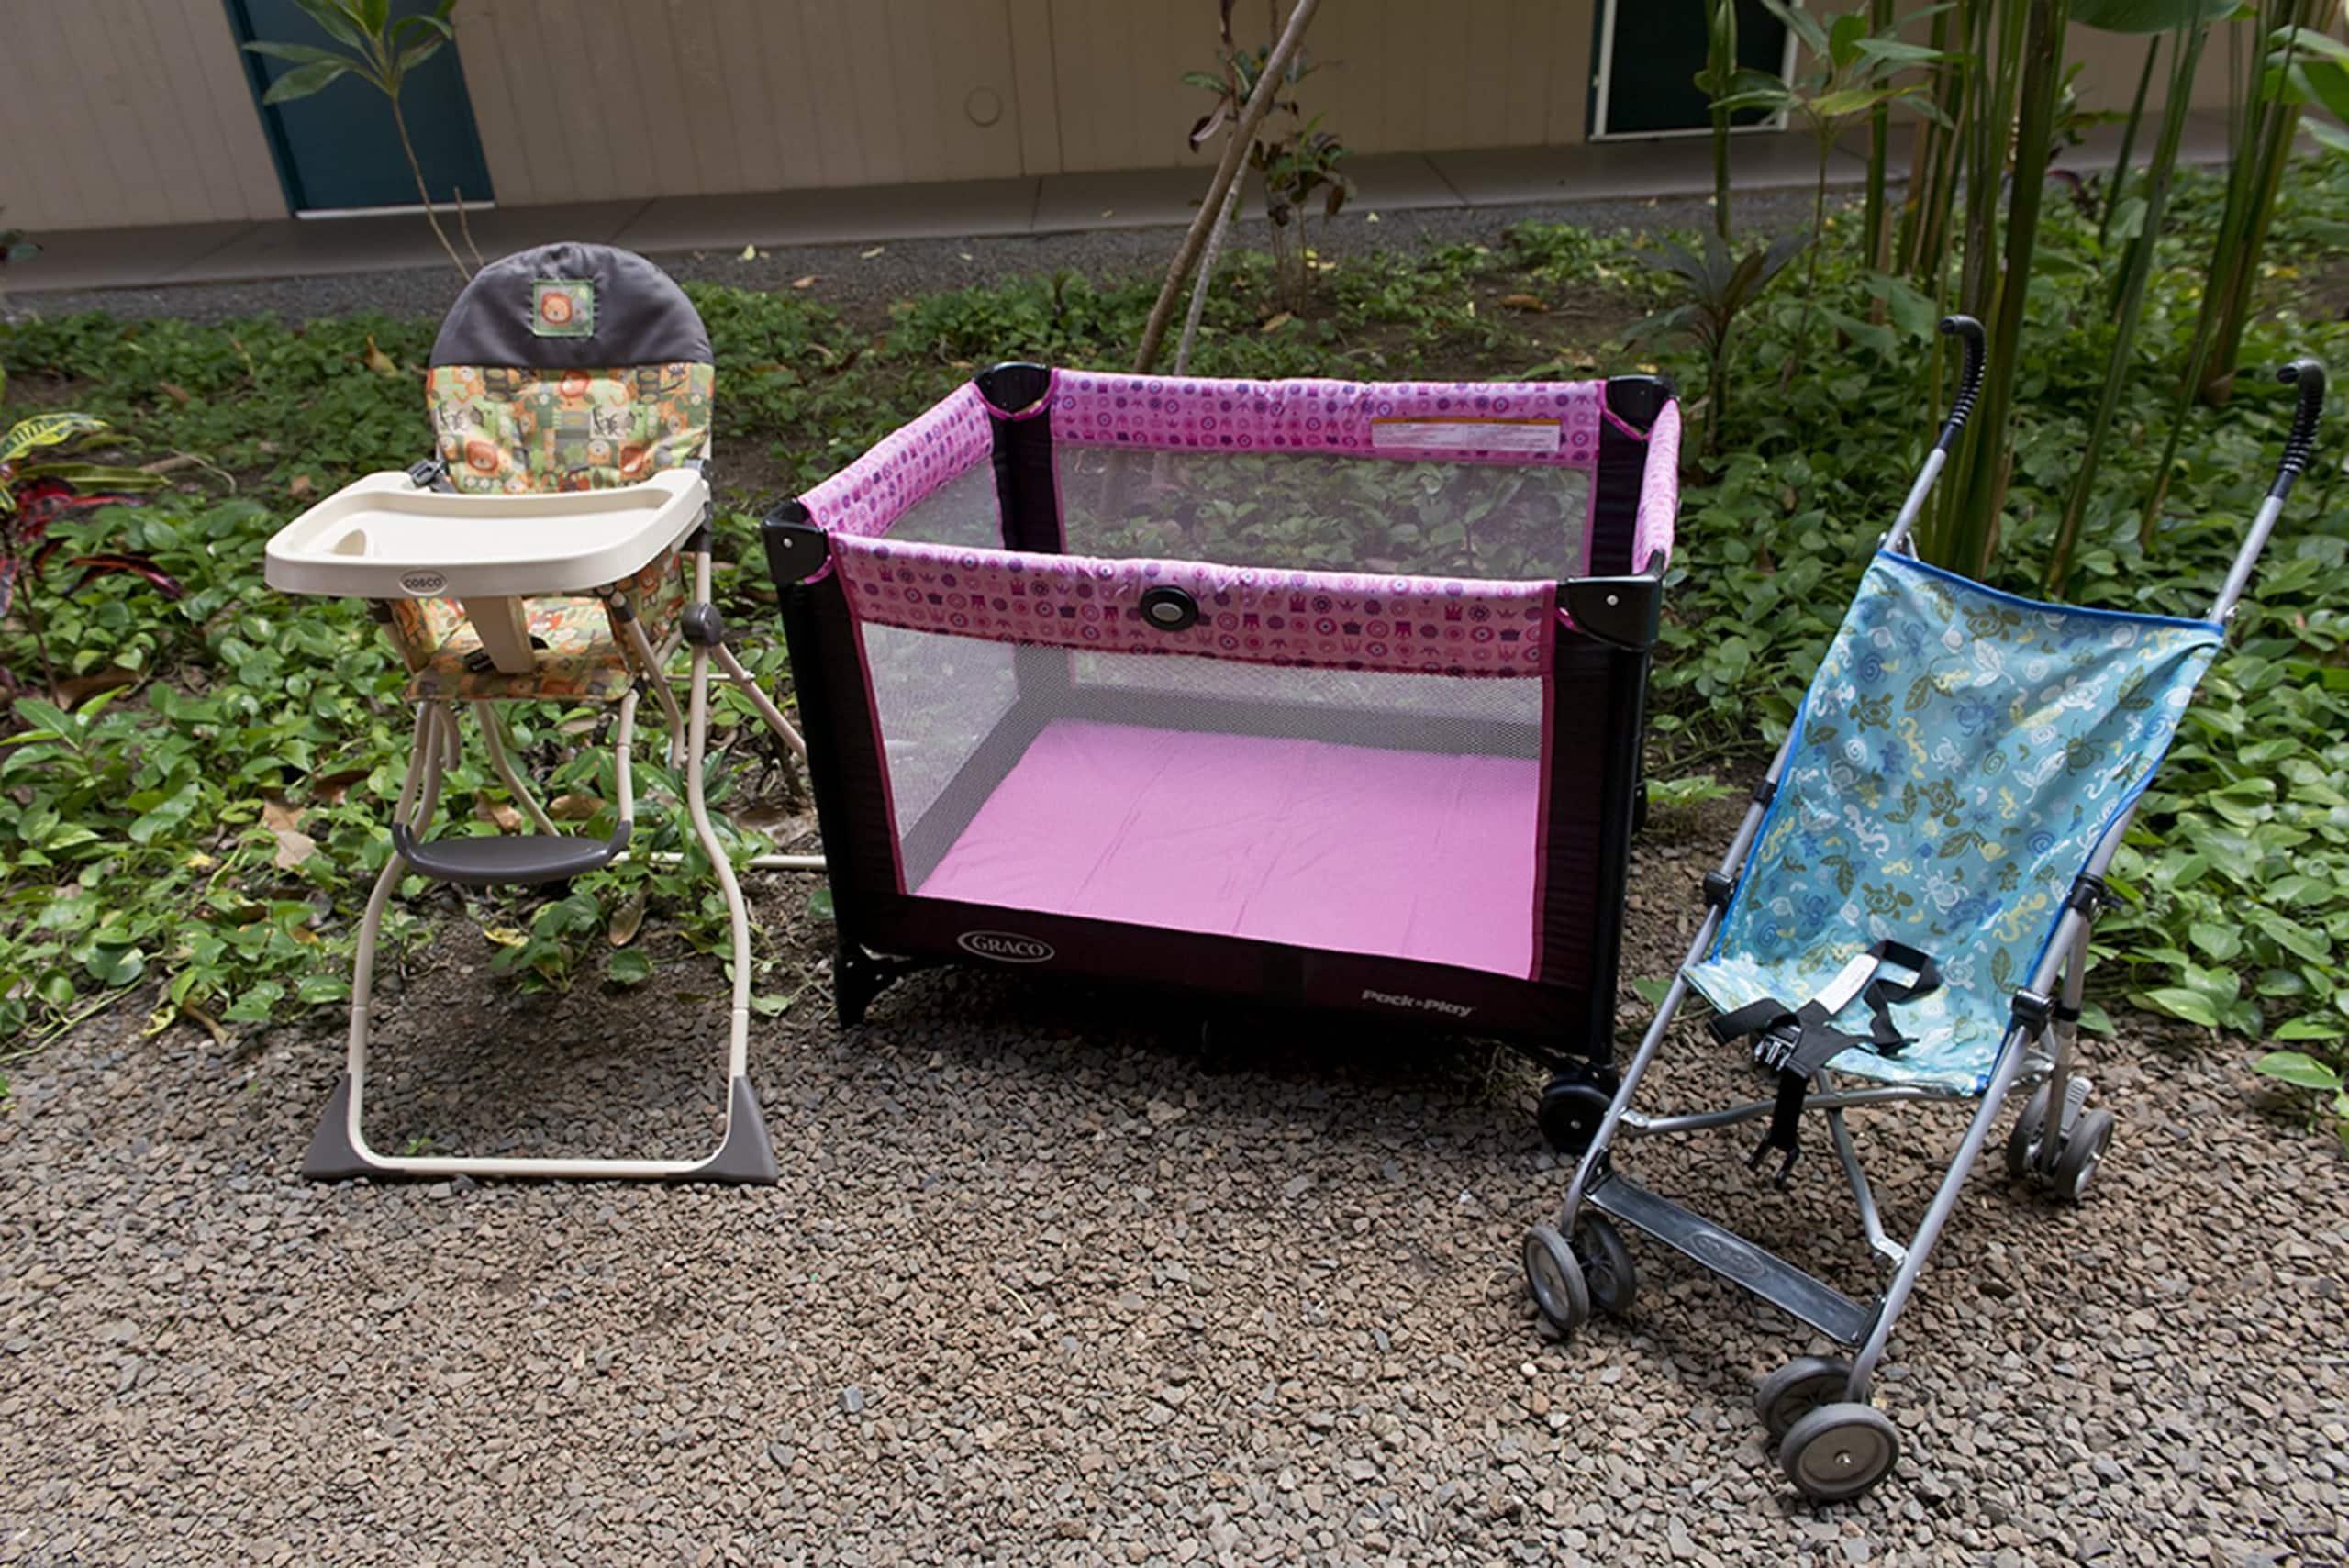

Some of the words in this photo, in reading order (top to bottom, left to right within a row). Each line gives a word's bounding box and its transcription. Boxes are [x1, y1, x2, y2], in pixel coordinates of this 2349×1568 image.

[404, 577, 442, 589] COSCO
[971, 934, 1045, 957] GRACO
[1361, 988, 1416, 1007] Pack
[1423, 998, 1473, 1018] Play
